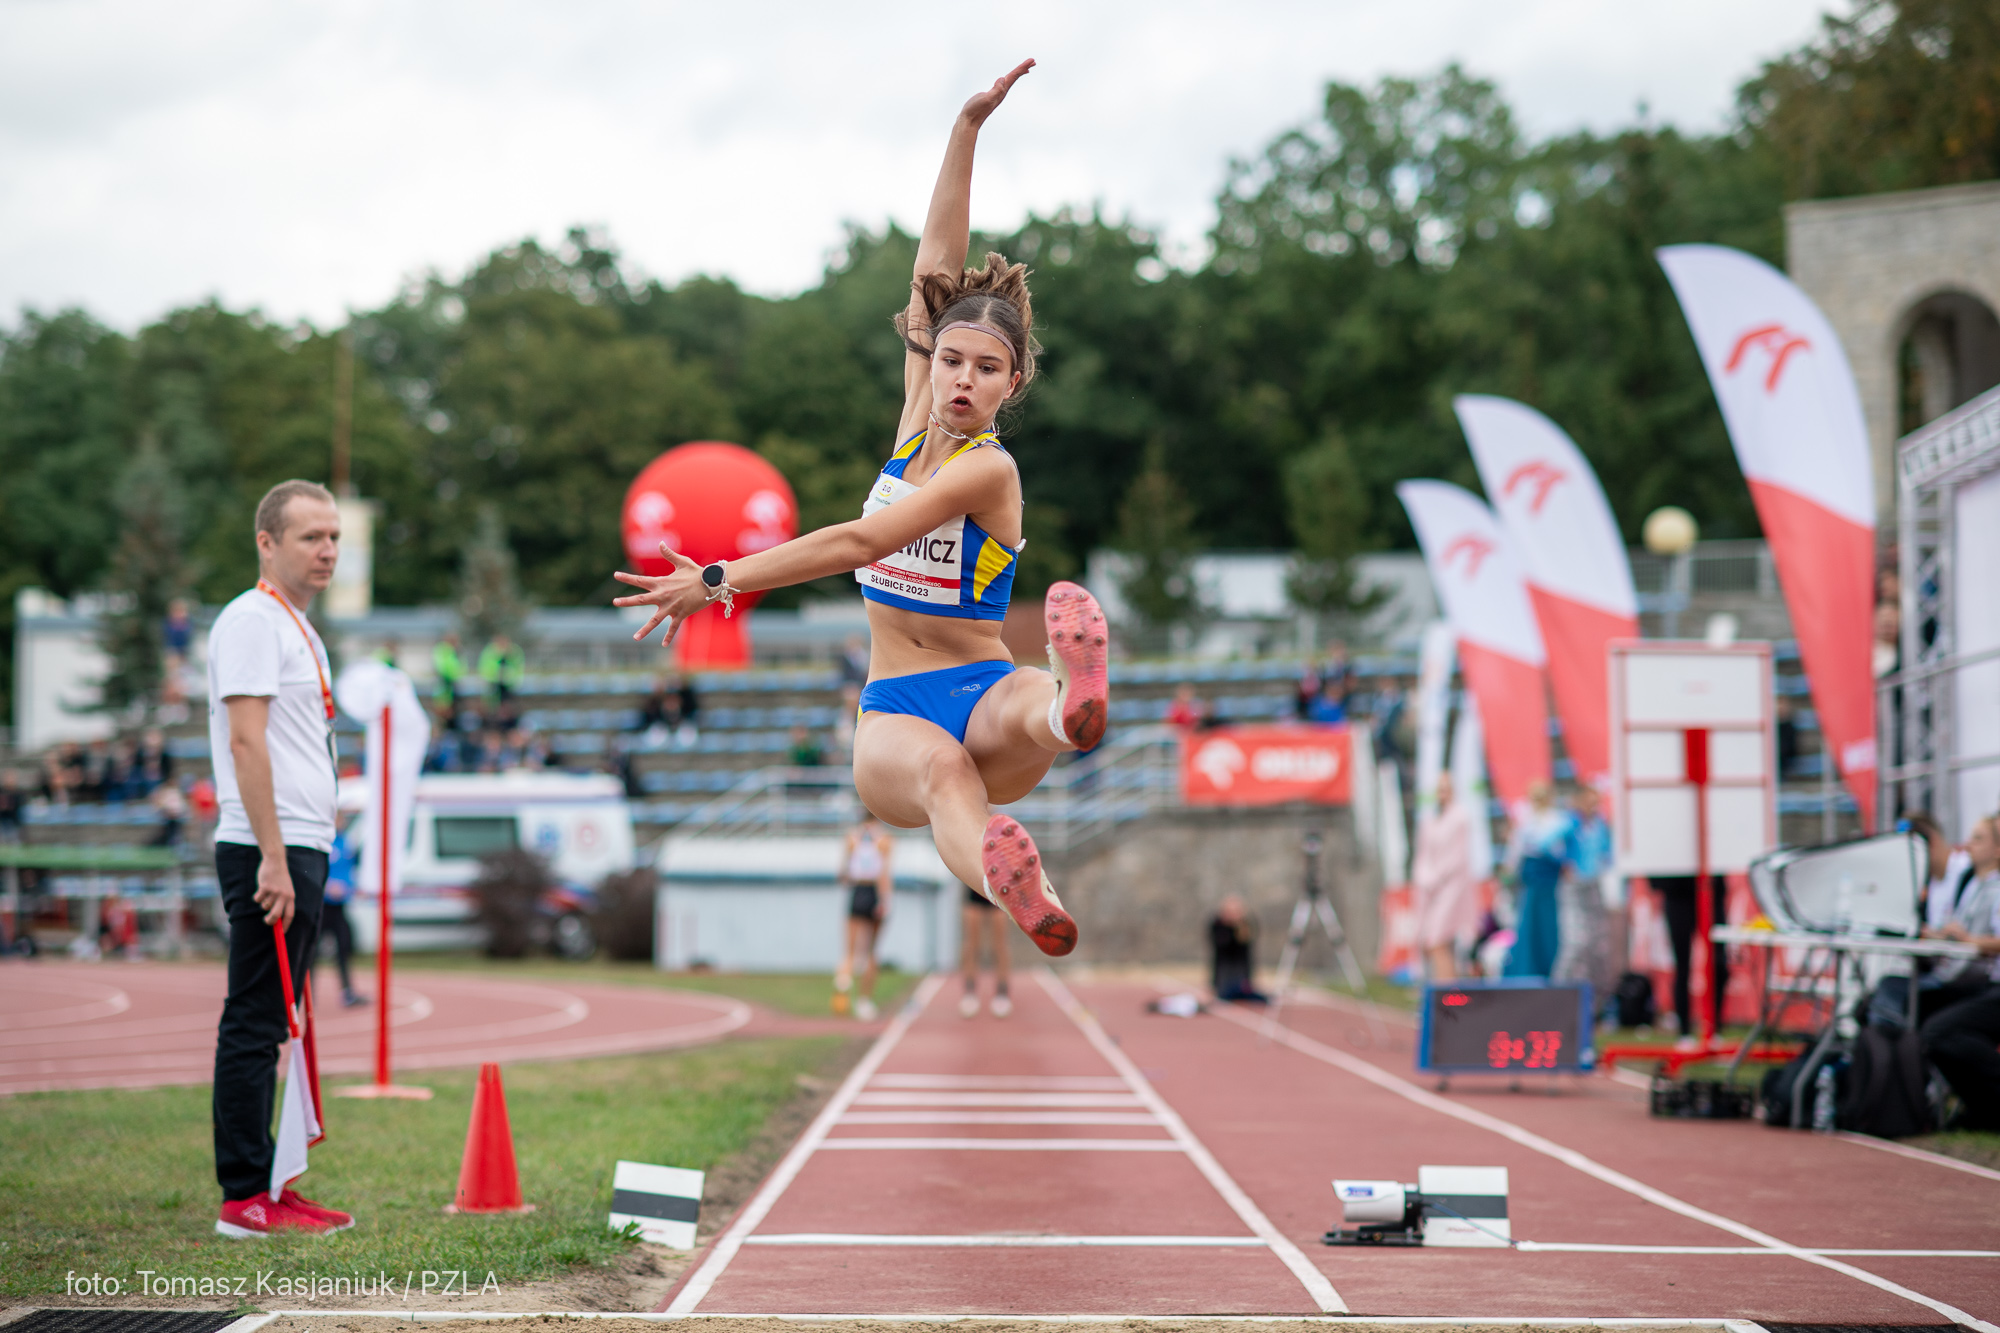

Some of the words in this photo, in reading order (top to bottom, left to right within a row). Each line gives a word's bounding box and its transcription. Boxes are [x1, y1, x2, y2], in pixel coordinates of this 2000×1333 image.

[898, 537, 956, 564] WICZ
[870, 574, 905, 591] SŁUBICE
[905, 584, 929, 597] 2023
